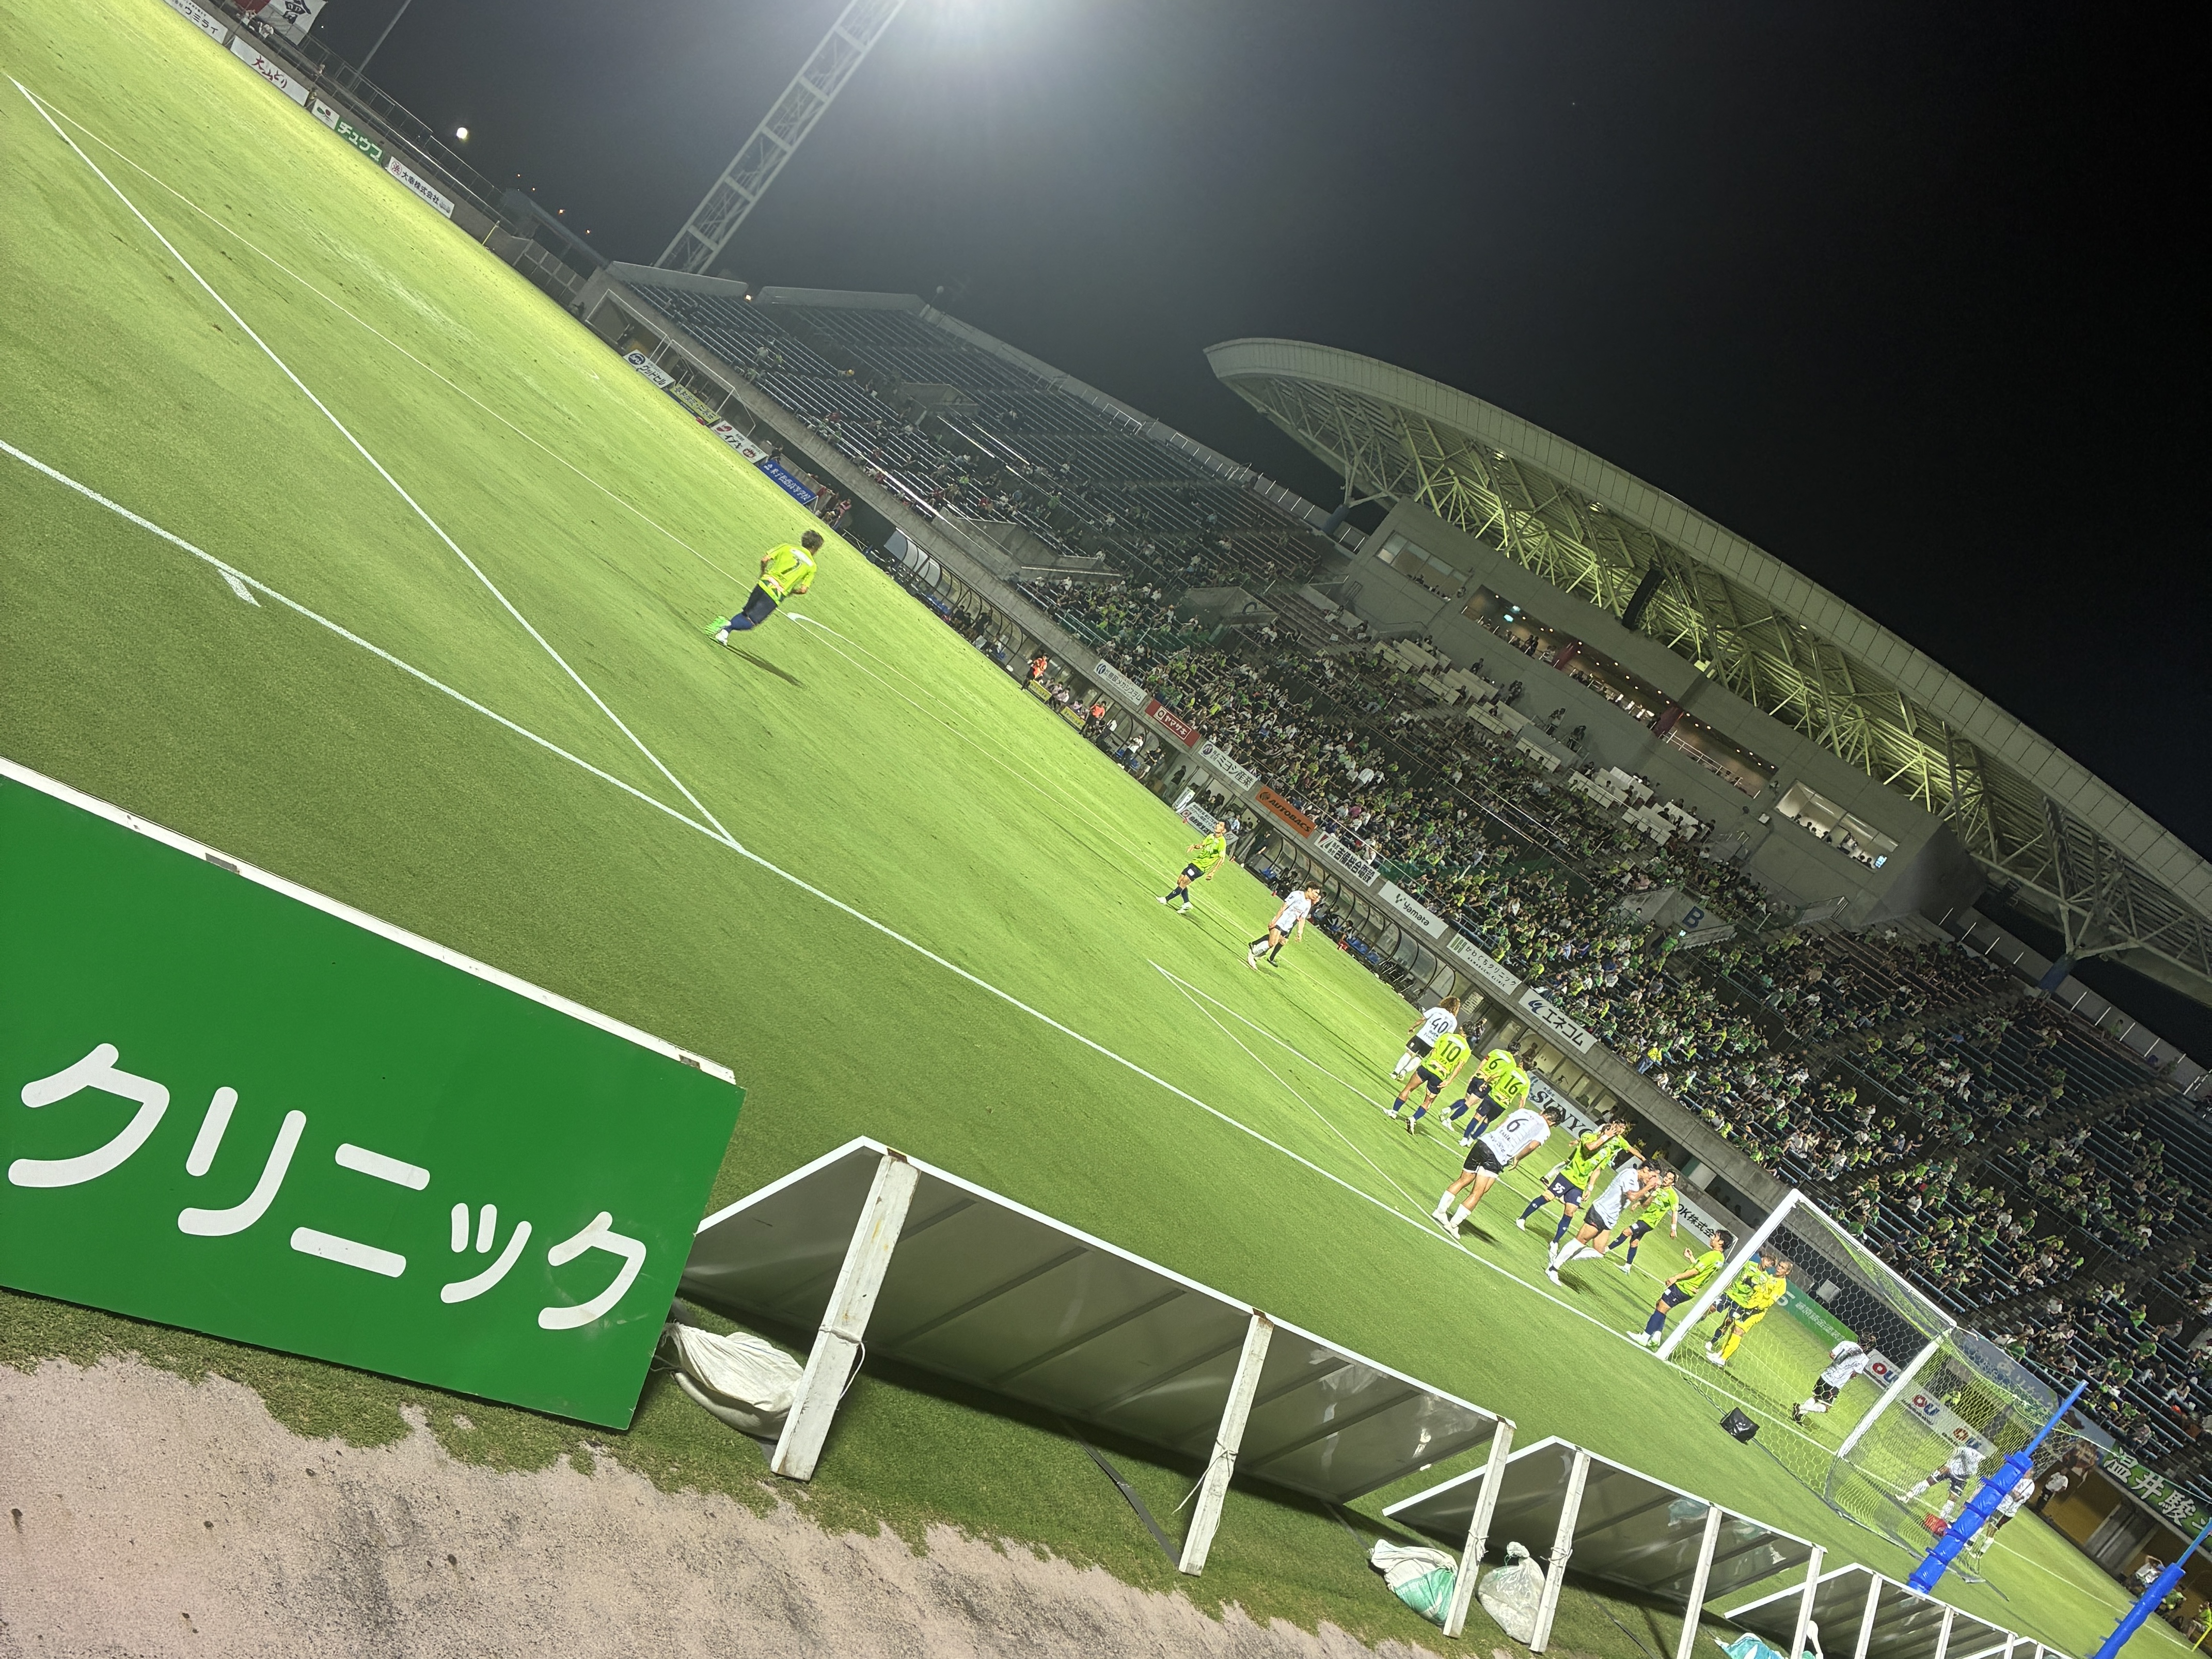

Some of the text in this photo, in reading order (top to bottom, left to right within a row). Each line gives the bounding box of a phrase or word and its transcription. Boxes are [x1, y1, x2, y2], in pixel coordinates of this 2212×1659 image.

[185, 6, 218, 34] ウミライ
[1217, 756, 1254, 788] ミヨシ産業
[1269, 800, 1311, 832] AUTOBACS
[1682, 906, 1704, 928] B
[1431, 1018, 1449, 1034] 40
[1542, 1009, 1583, 1046] エネコム
[1440, 1041, 1461, 1062] 10
[1489, 1058, 1503, 1070] 6
[1504, 1076, 1523, 1095] 16
[1507, 1118, 1529, 1133] 6
[8, 1042, 646, 1331] クリニック
[1552, 1183, 1566, 1193] 55
[1678, 1204, 1716, 1238] OK株式会
